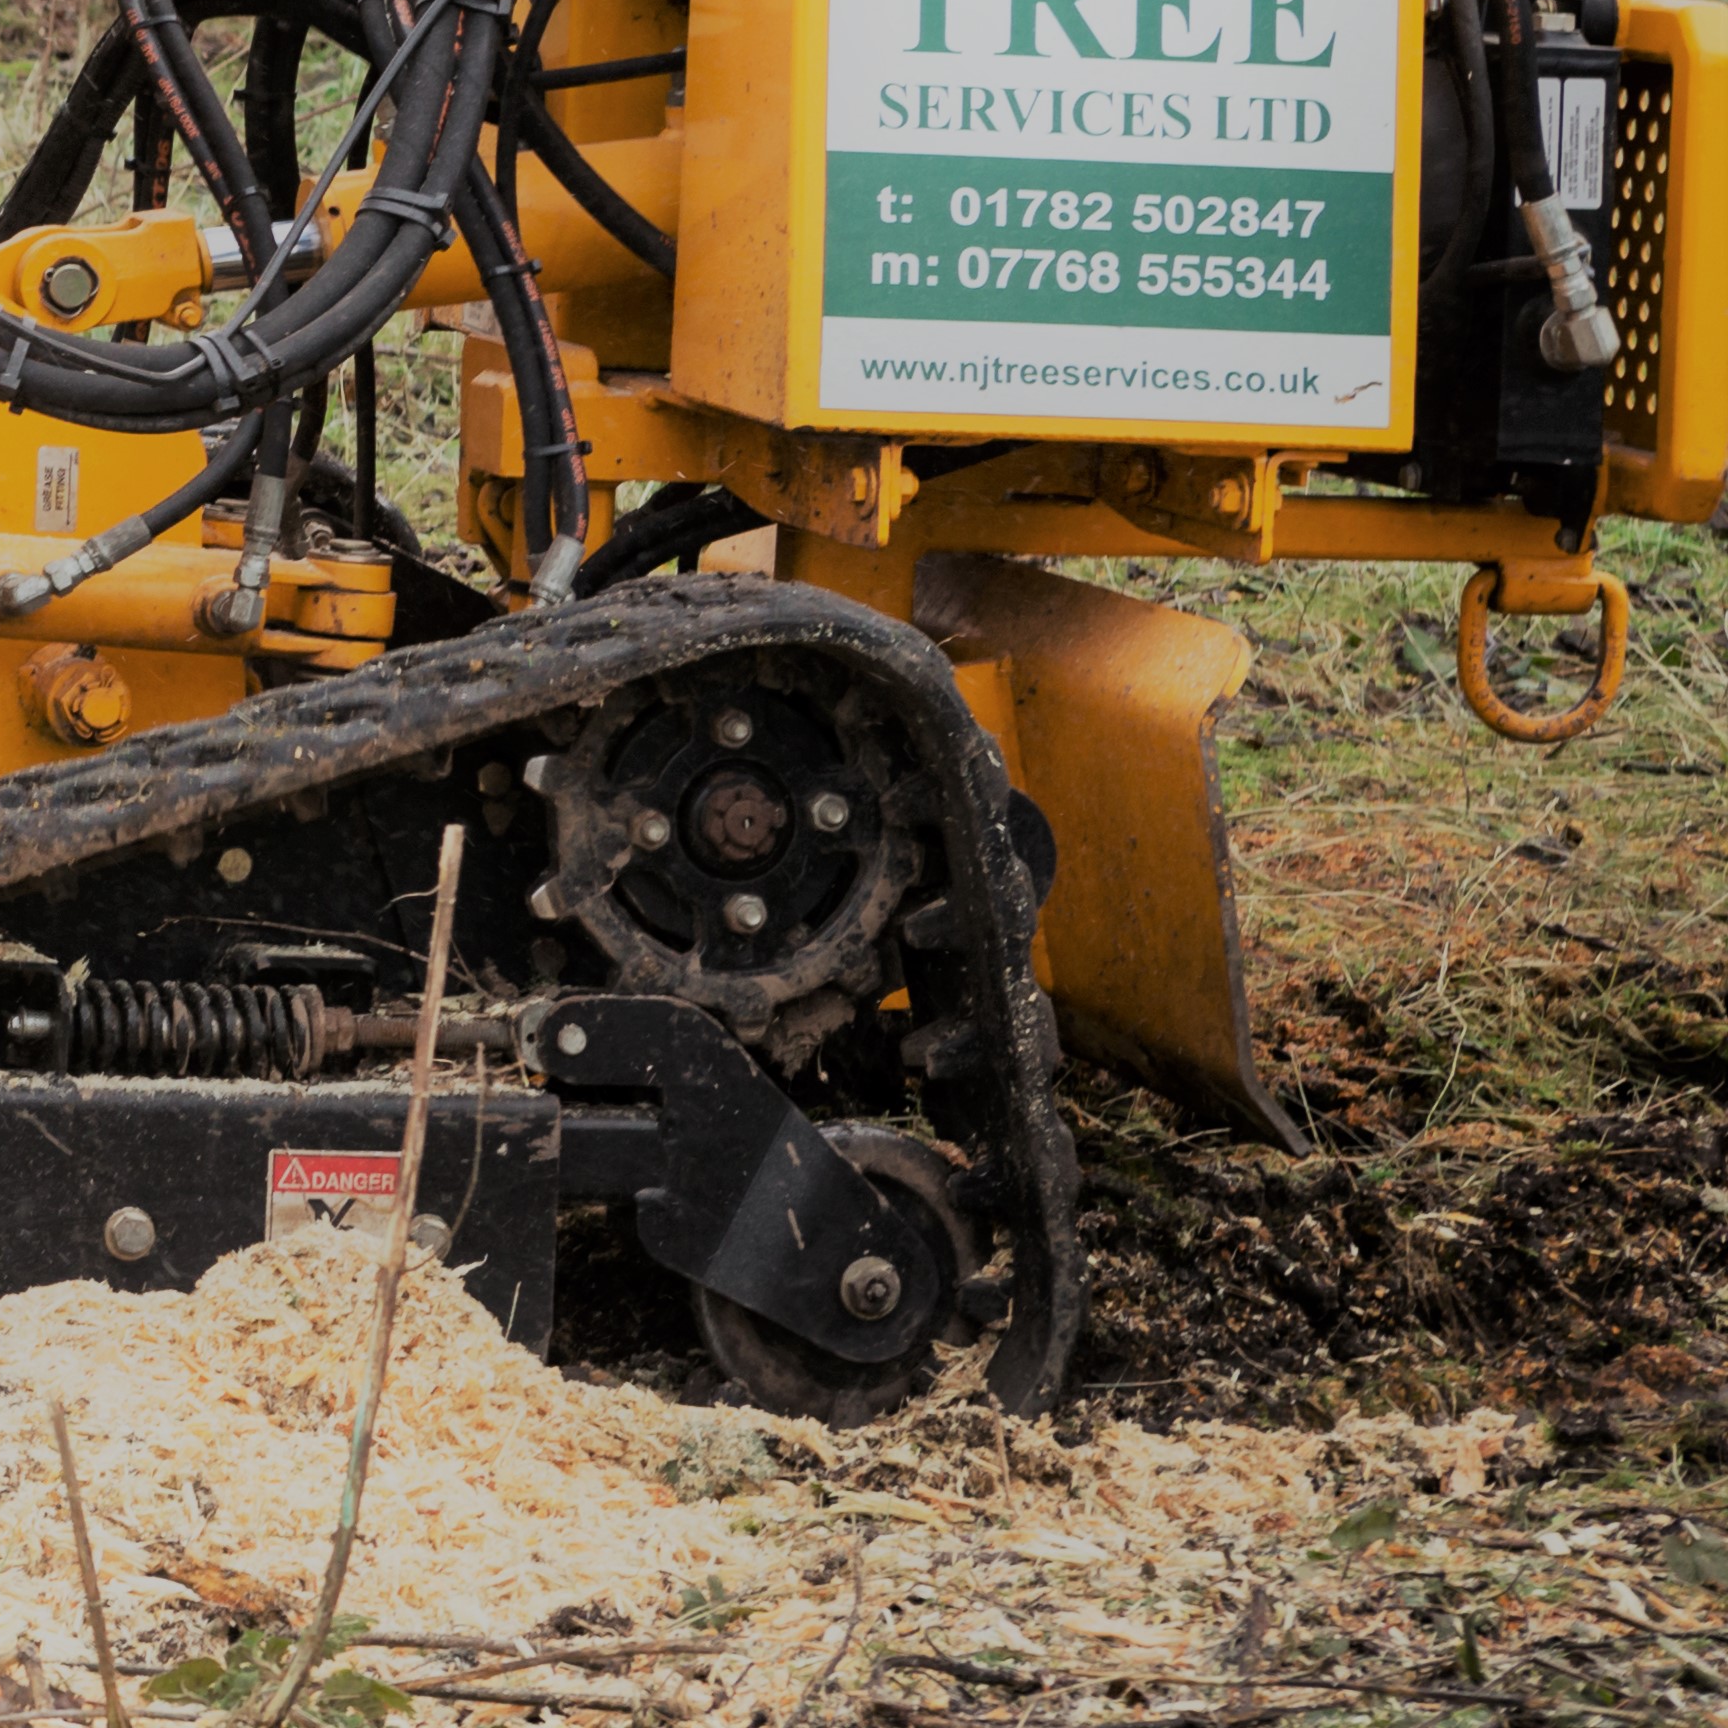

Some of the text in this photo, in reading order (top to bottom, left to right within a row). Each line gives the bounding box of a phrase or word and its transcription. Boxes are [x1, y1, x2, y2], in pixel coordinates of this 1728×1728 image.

[878, 83, 1332, 144] SERVICES LTD
[877, 185, 1326, 239] t: 01782 502847
[870, 247, 1331, 302] m: 07768 555344
[861, 356, 1321, 398] www.njtreeservices.co.uk
[43, 465, 53, 512] GREASE
[55, 468, 65, 510] FITTING
[311, 1171, 394, 1191] DANGER
